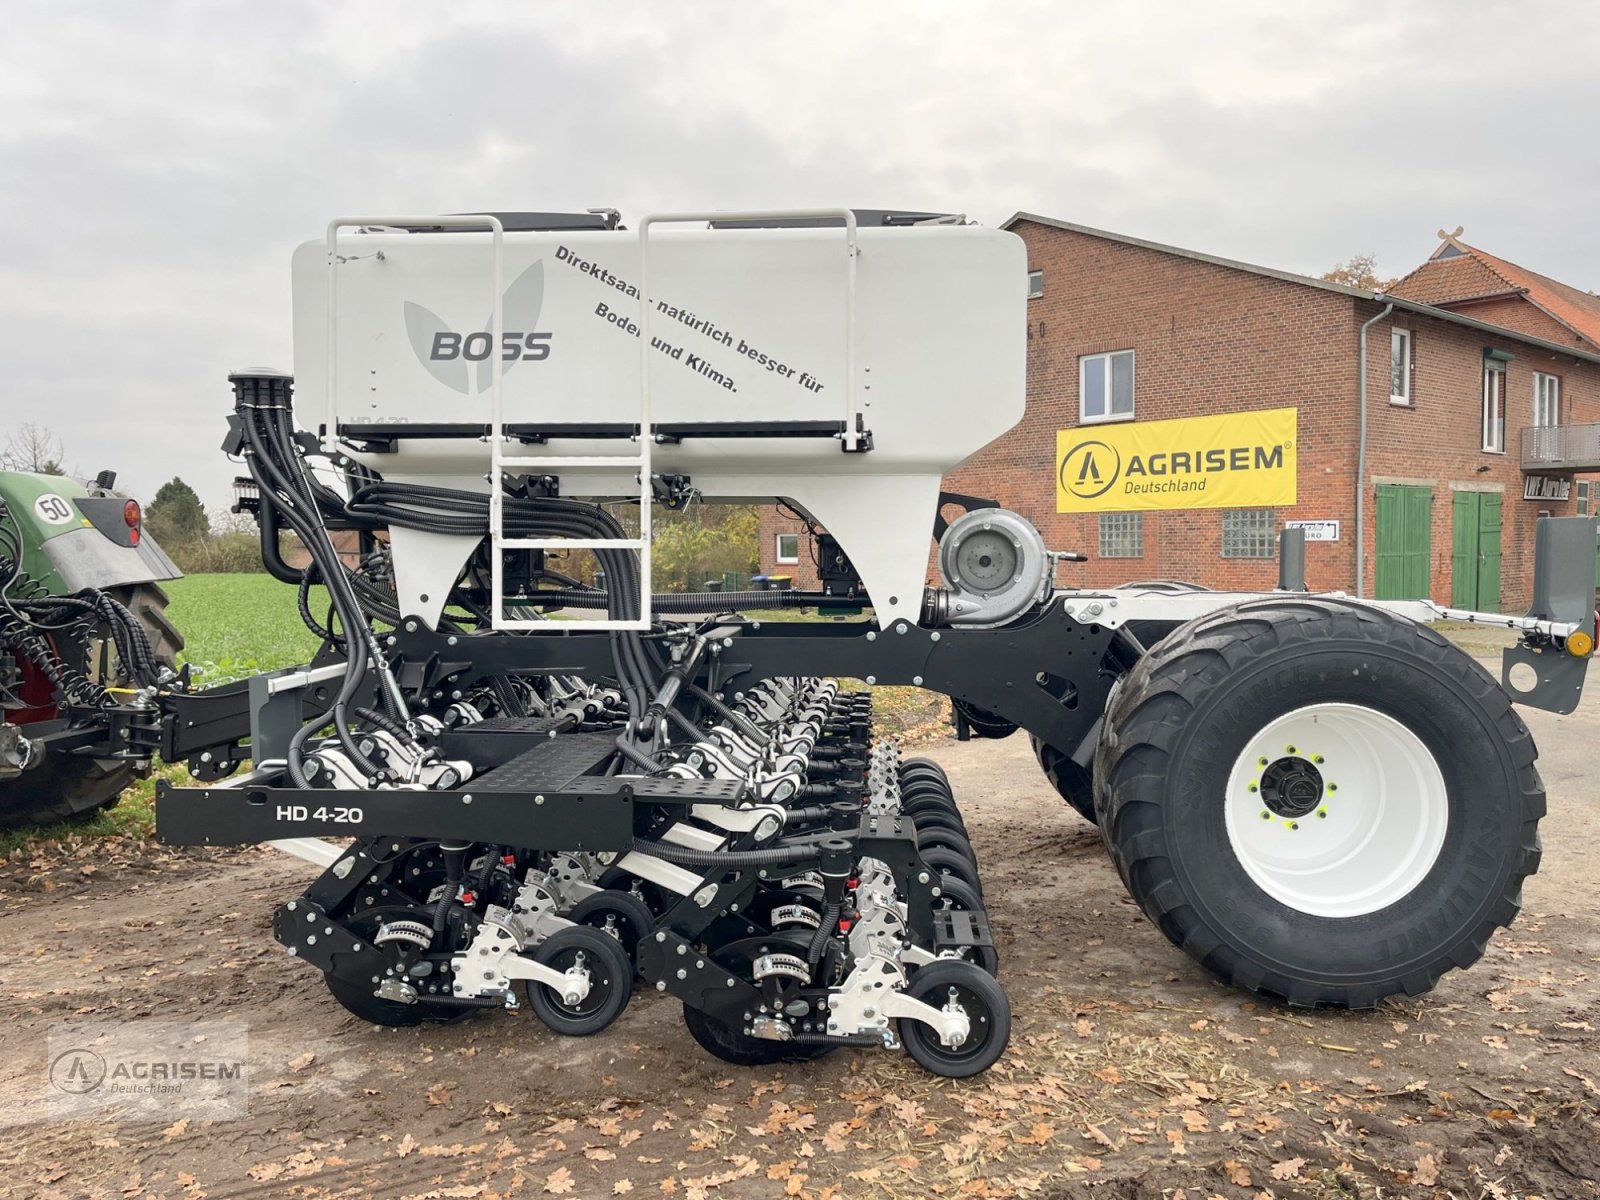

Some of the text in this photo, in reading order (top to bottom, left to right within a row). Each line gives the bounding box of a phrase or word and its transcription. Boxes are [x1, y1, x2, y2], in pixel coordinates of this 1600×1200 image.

[429, 331, 553, 362] BOSS
[656, 299, 734, 347] natürlich
[736, 339, 796, 379] besser
[798, 371, 825, 395] für
[650, 336, 684, 360] und
[685, 353, 738, 393] Klima.
[1125, 444, 1283, 477] AGRISEM
[1124, 478, 1207, 494] Deutschland
[38, 497, 70, 521] 50
[276, 805, 364, 824] HD 4-20
